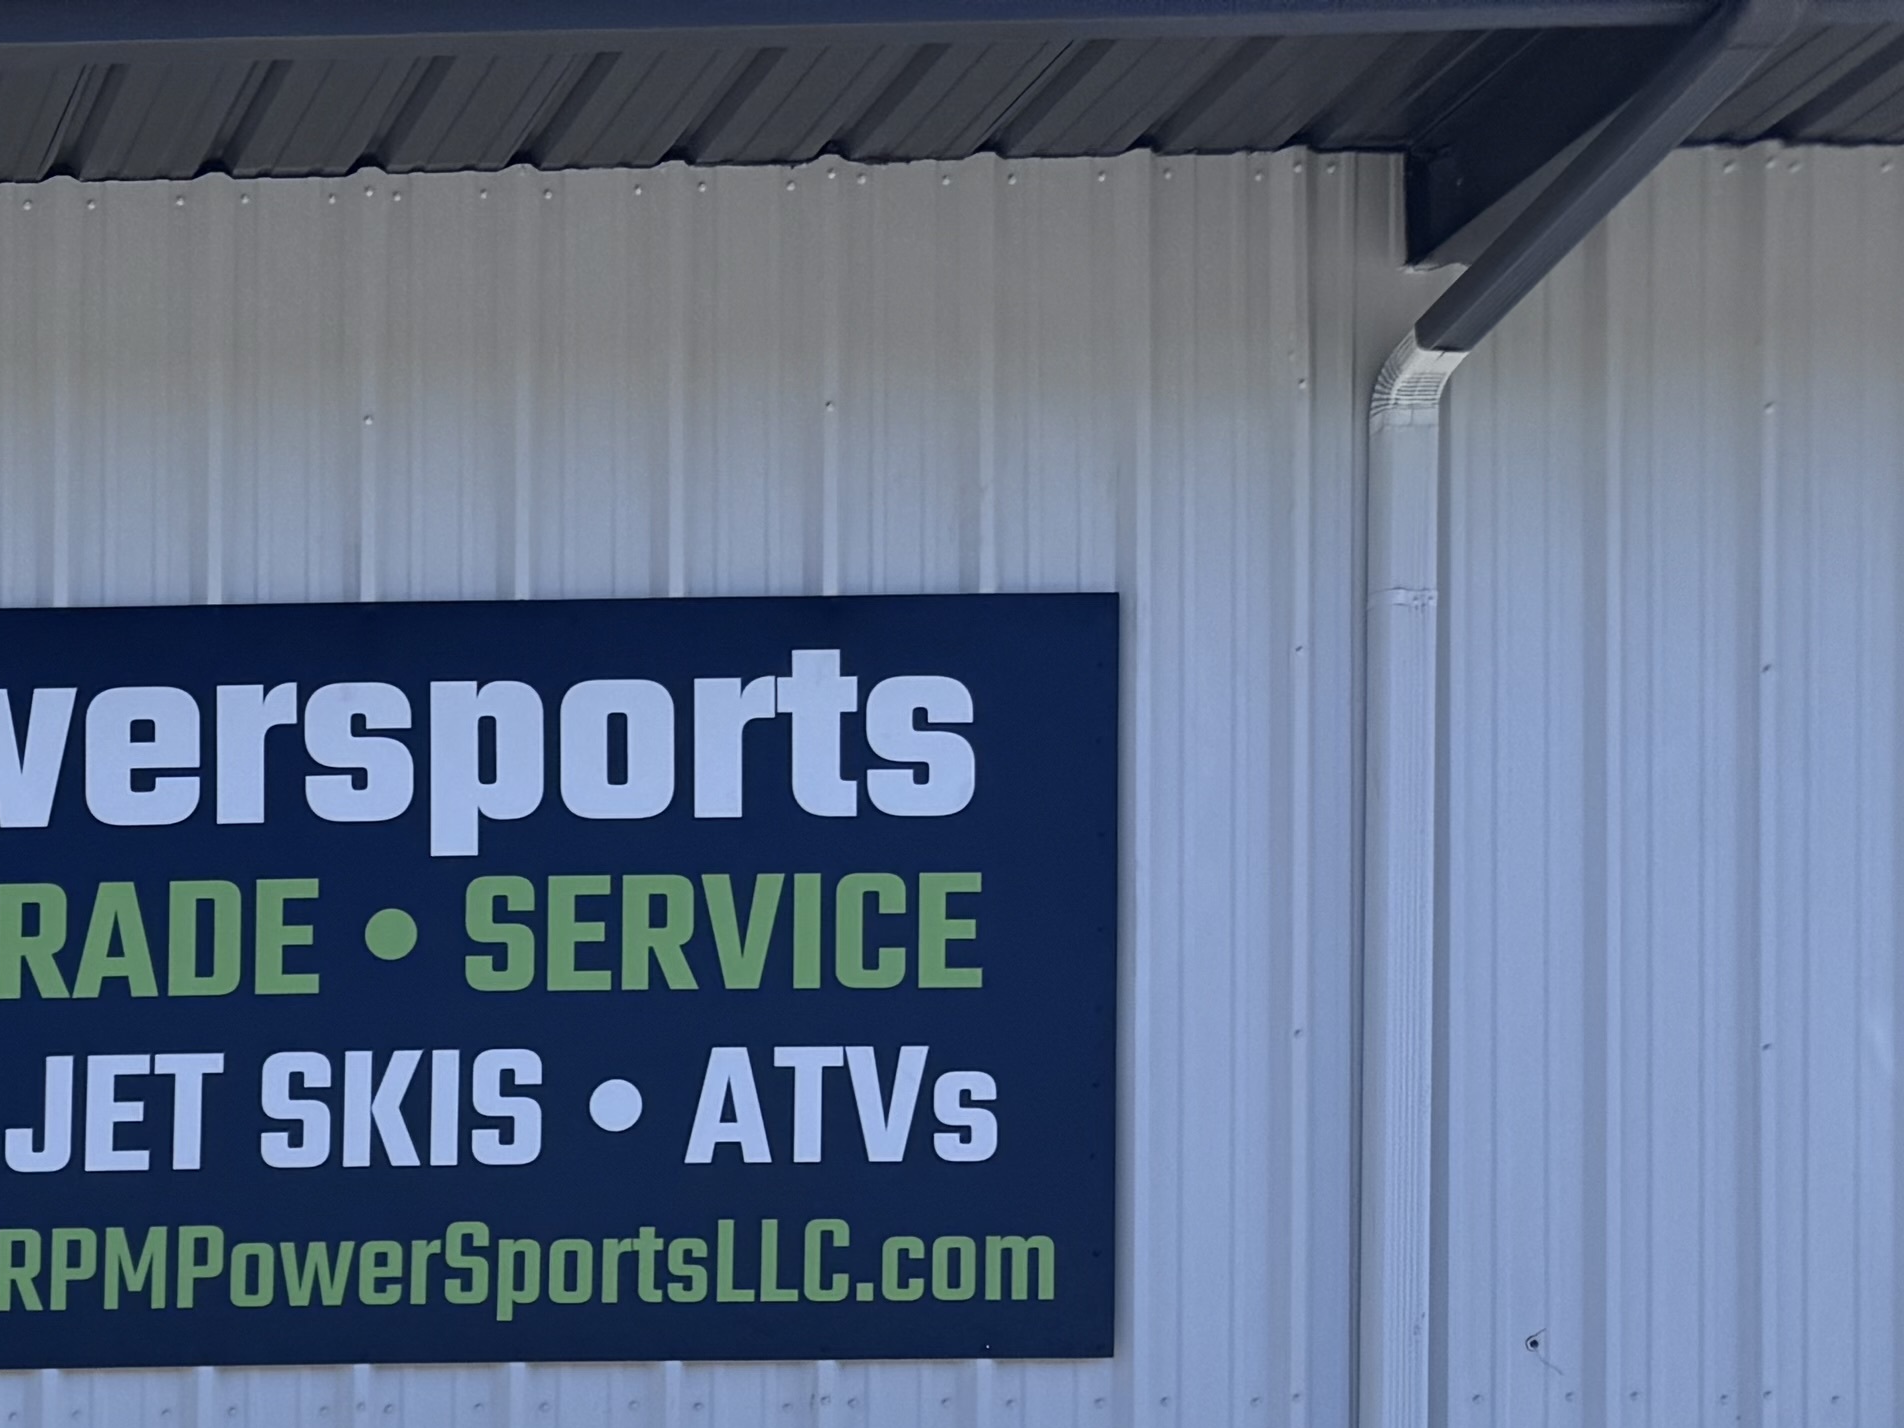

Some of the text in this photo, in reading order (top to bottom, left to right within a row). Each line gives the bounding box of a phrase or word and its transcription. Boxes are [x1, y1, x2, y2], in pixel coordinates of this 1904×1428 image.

[465, 871, 983, 992] SERVICE
[4, 1052, 225, 1173] JET
[260, 1048, 543, 1168] SKIS
[684, 1045, 998, 1164] ATVs
